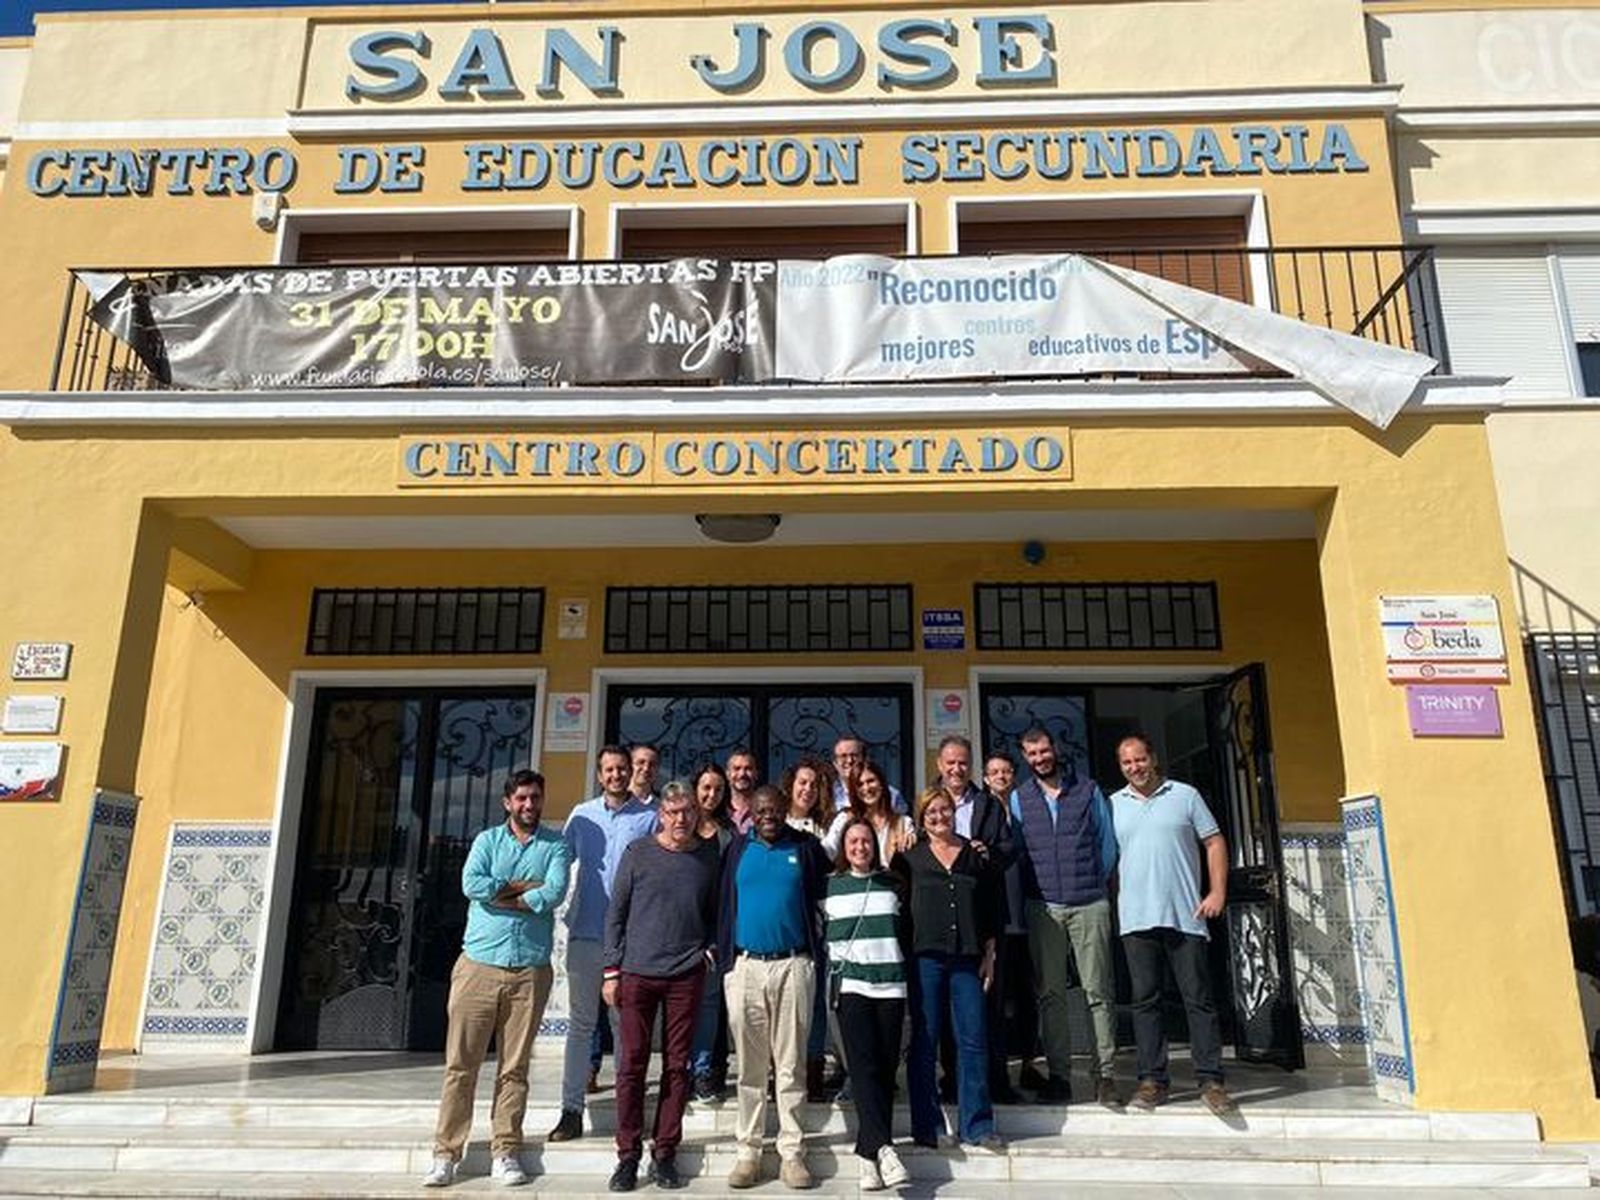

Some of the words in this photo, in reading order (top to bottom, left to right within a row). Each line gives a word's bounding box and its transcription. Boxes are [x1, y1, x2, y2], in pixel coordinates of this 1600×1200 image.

[346, 27, 622, 99] SAN
[692, 15, 1056, 91] JOSE
[27, 147, 297, 197] CENTRO
[334, 145, 425, 193] DE
[461, 137, 862, 190] EDUCACION
[902, 123, 1367, 183] SECUNDARIA
[283, 270, 332, 294] DE
[346, 264, 518, 290] PUERTAS
[528, 259, 718, 286] ABIERTAS
[731, 259, 776, 283] FP
[818, 263, 866, 288] 2022
[867, 269, 1057, 306] "Reconocido
[289, 298, 335, 328] 31
[350, 297, 408, 326] DE
[419, 296, 562, 325] MAYO
[647, 302, 698, 344] SAN
[964, 315, 1036, 336] centros
[880, 335, 976, 365] mejores
[1029, 333, 1133, 357] educativos
[1137, 335, 1160, 355] de
[1166, 318, 1219, 361] Esp
[403, 440, 645, 478] CENTRO
[664, 434, 1065, 476] CONCERTADO
[1431, 628, 1482, 649] beda
[1418, 695, 1485, 711] TRINITY
